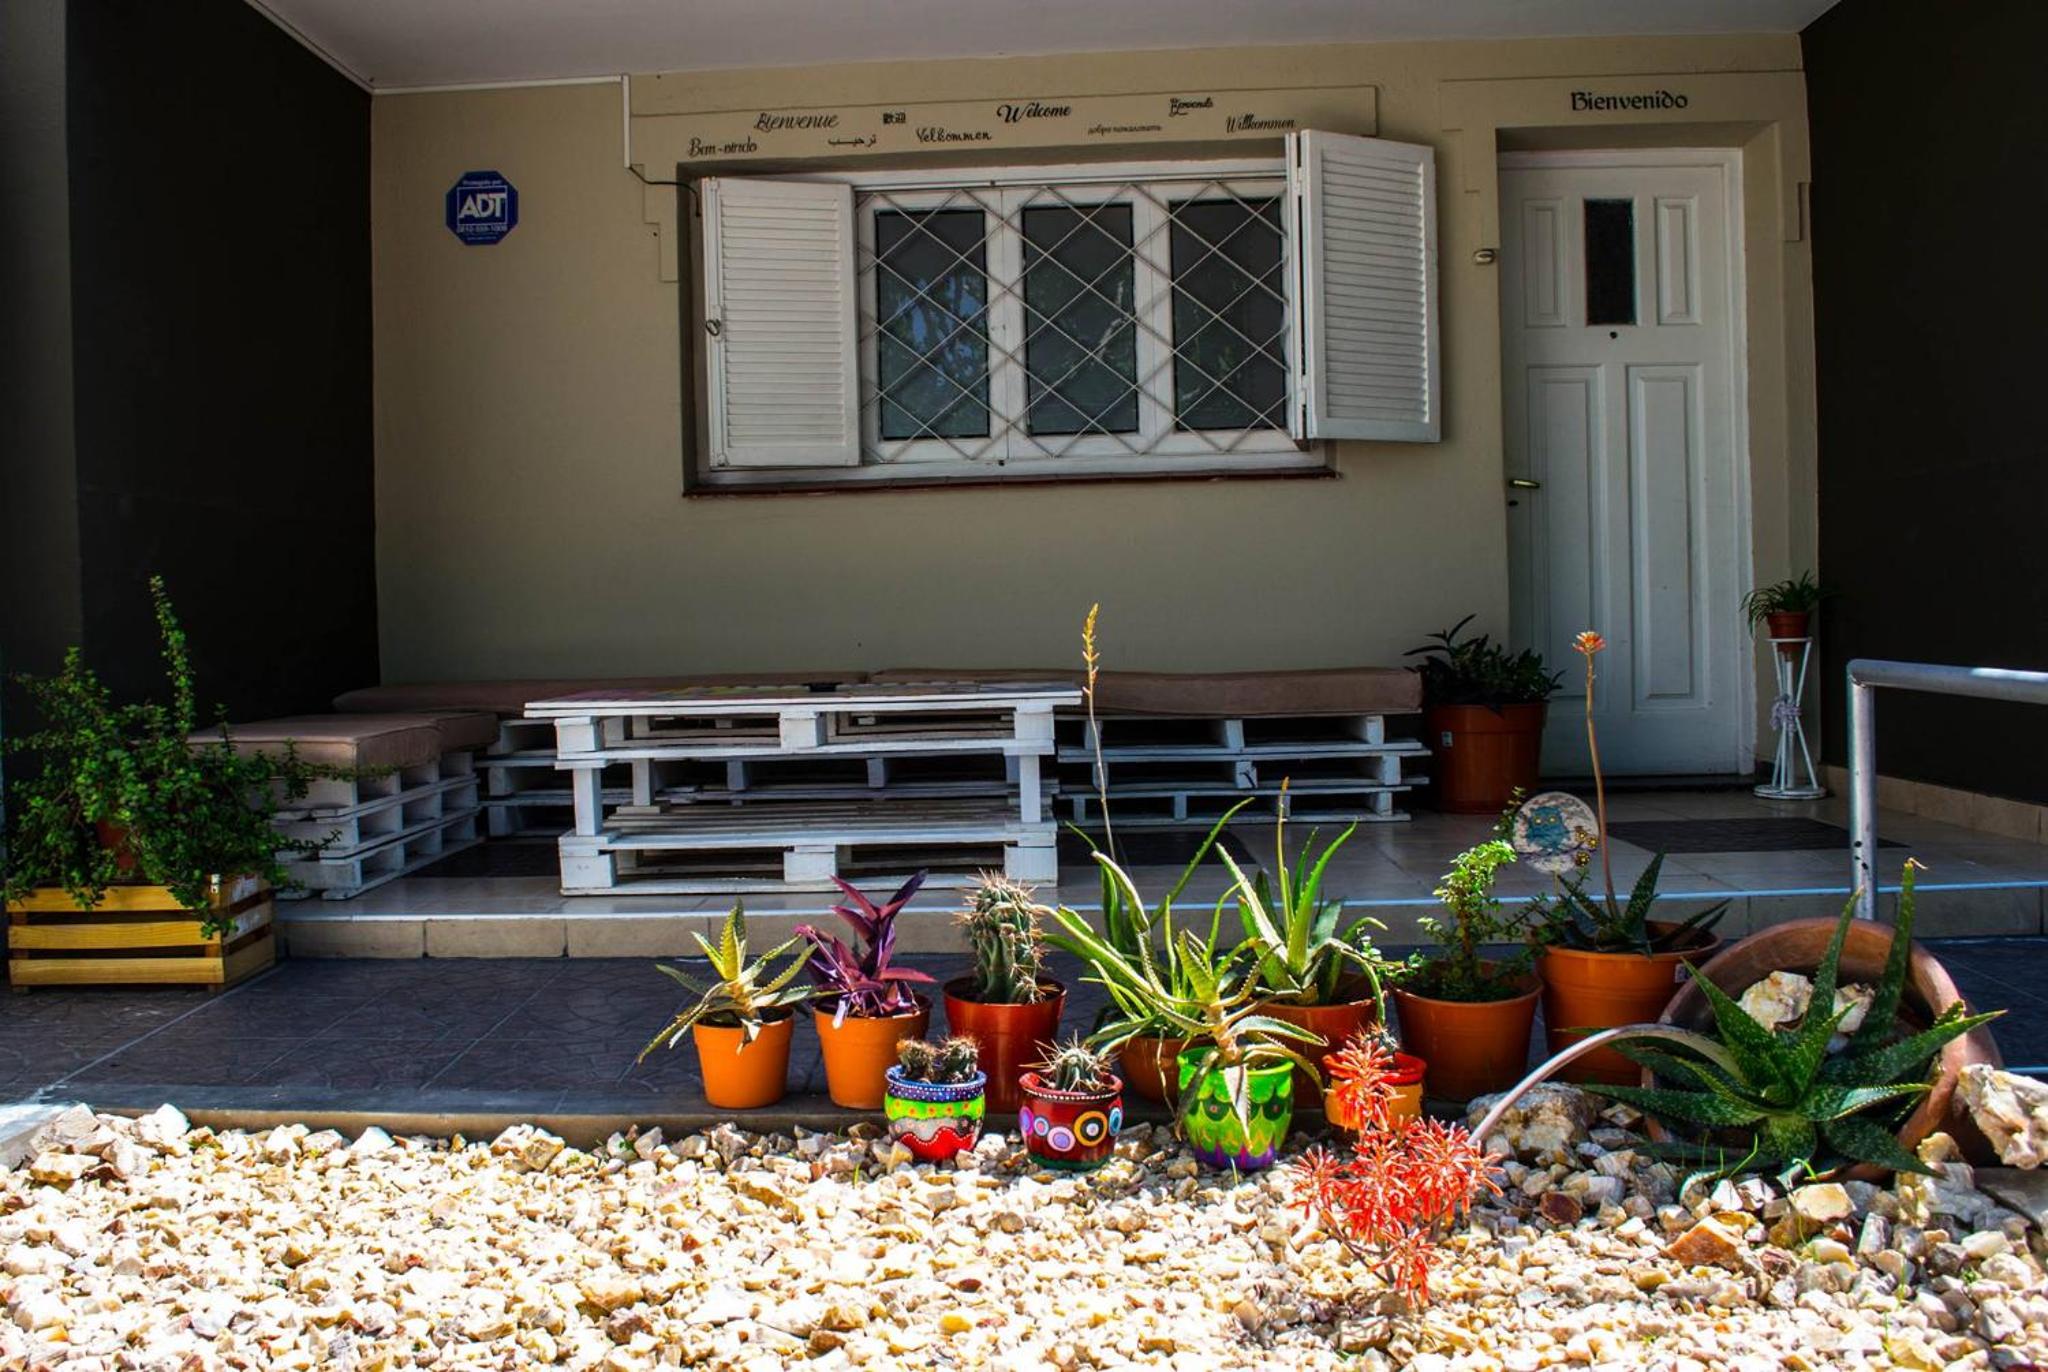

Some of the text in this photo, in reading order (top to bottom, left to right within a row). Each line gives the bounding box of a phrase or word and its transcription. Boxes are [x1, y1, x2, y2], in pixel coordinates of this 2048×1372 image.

[1570, 90, 1689, 111] Bienvenido
[753, 112, 839, 133] Bienvenue
[996, 102, 1071, 123] Welcome
[1226, 113, 1295, 133] Willkommen
[459, 193, 507, 218] ADT
